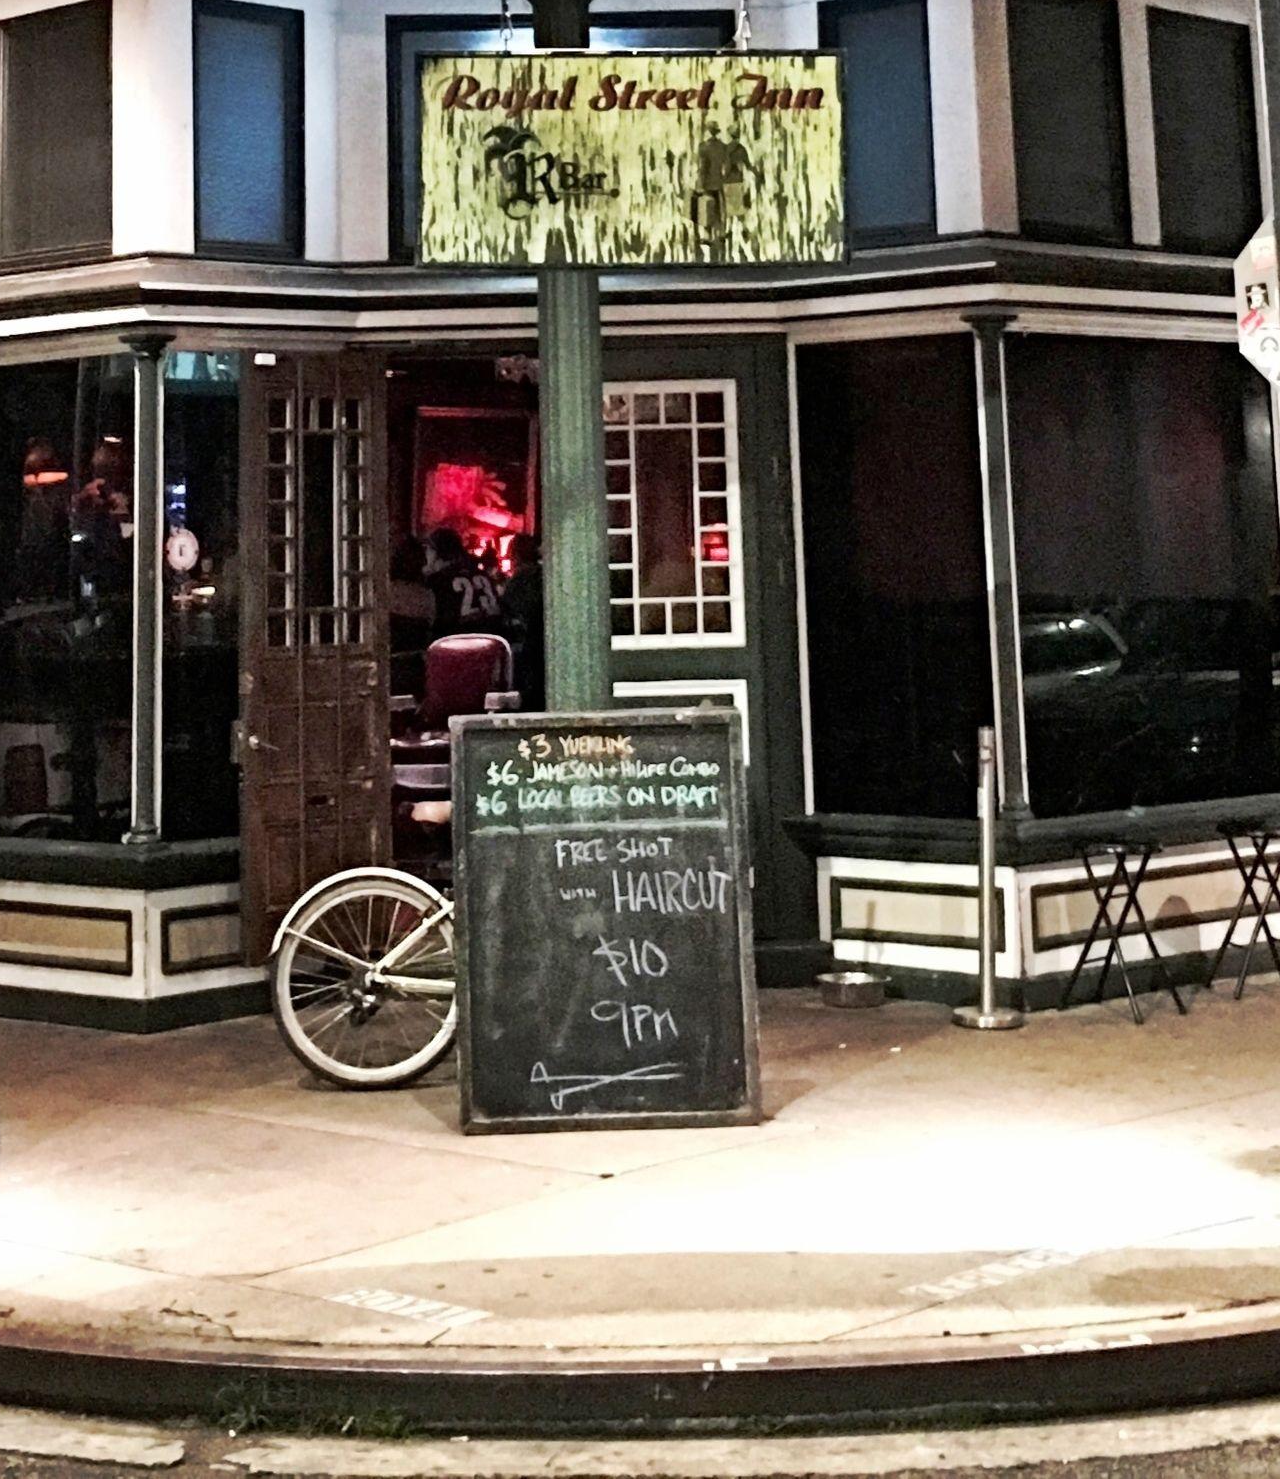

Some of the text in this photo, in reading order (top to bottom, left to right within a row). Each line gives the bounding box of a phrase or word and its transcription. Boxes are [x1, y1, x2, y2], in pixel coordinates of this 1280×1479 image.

[440, 72, 825, 118] Royal Street Inn
[559, 161, 608, 190] Bar
[518, 733, 552, 761] $3
[487, 759, 520, 786] $6
[526, 759, 604, 783] JAMESON
[475, 784, 718, 816] $6 LOCAL BEERS ON DRAFT
[554, 837, 673, 868] FREE SHOT
[612, 867, 733, 915] HAIRCUT
[592, 935, 669, 986] $10
